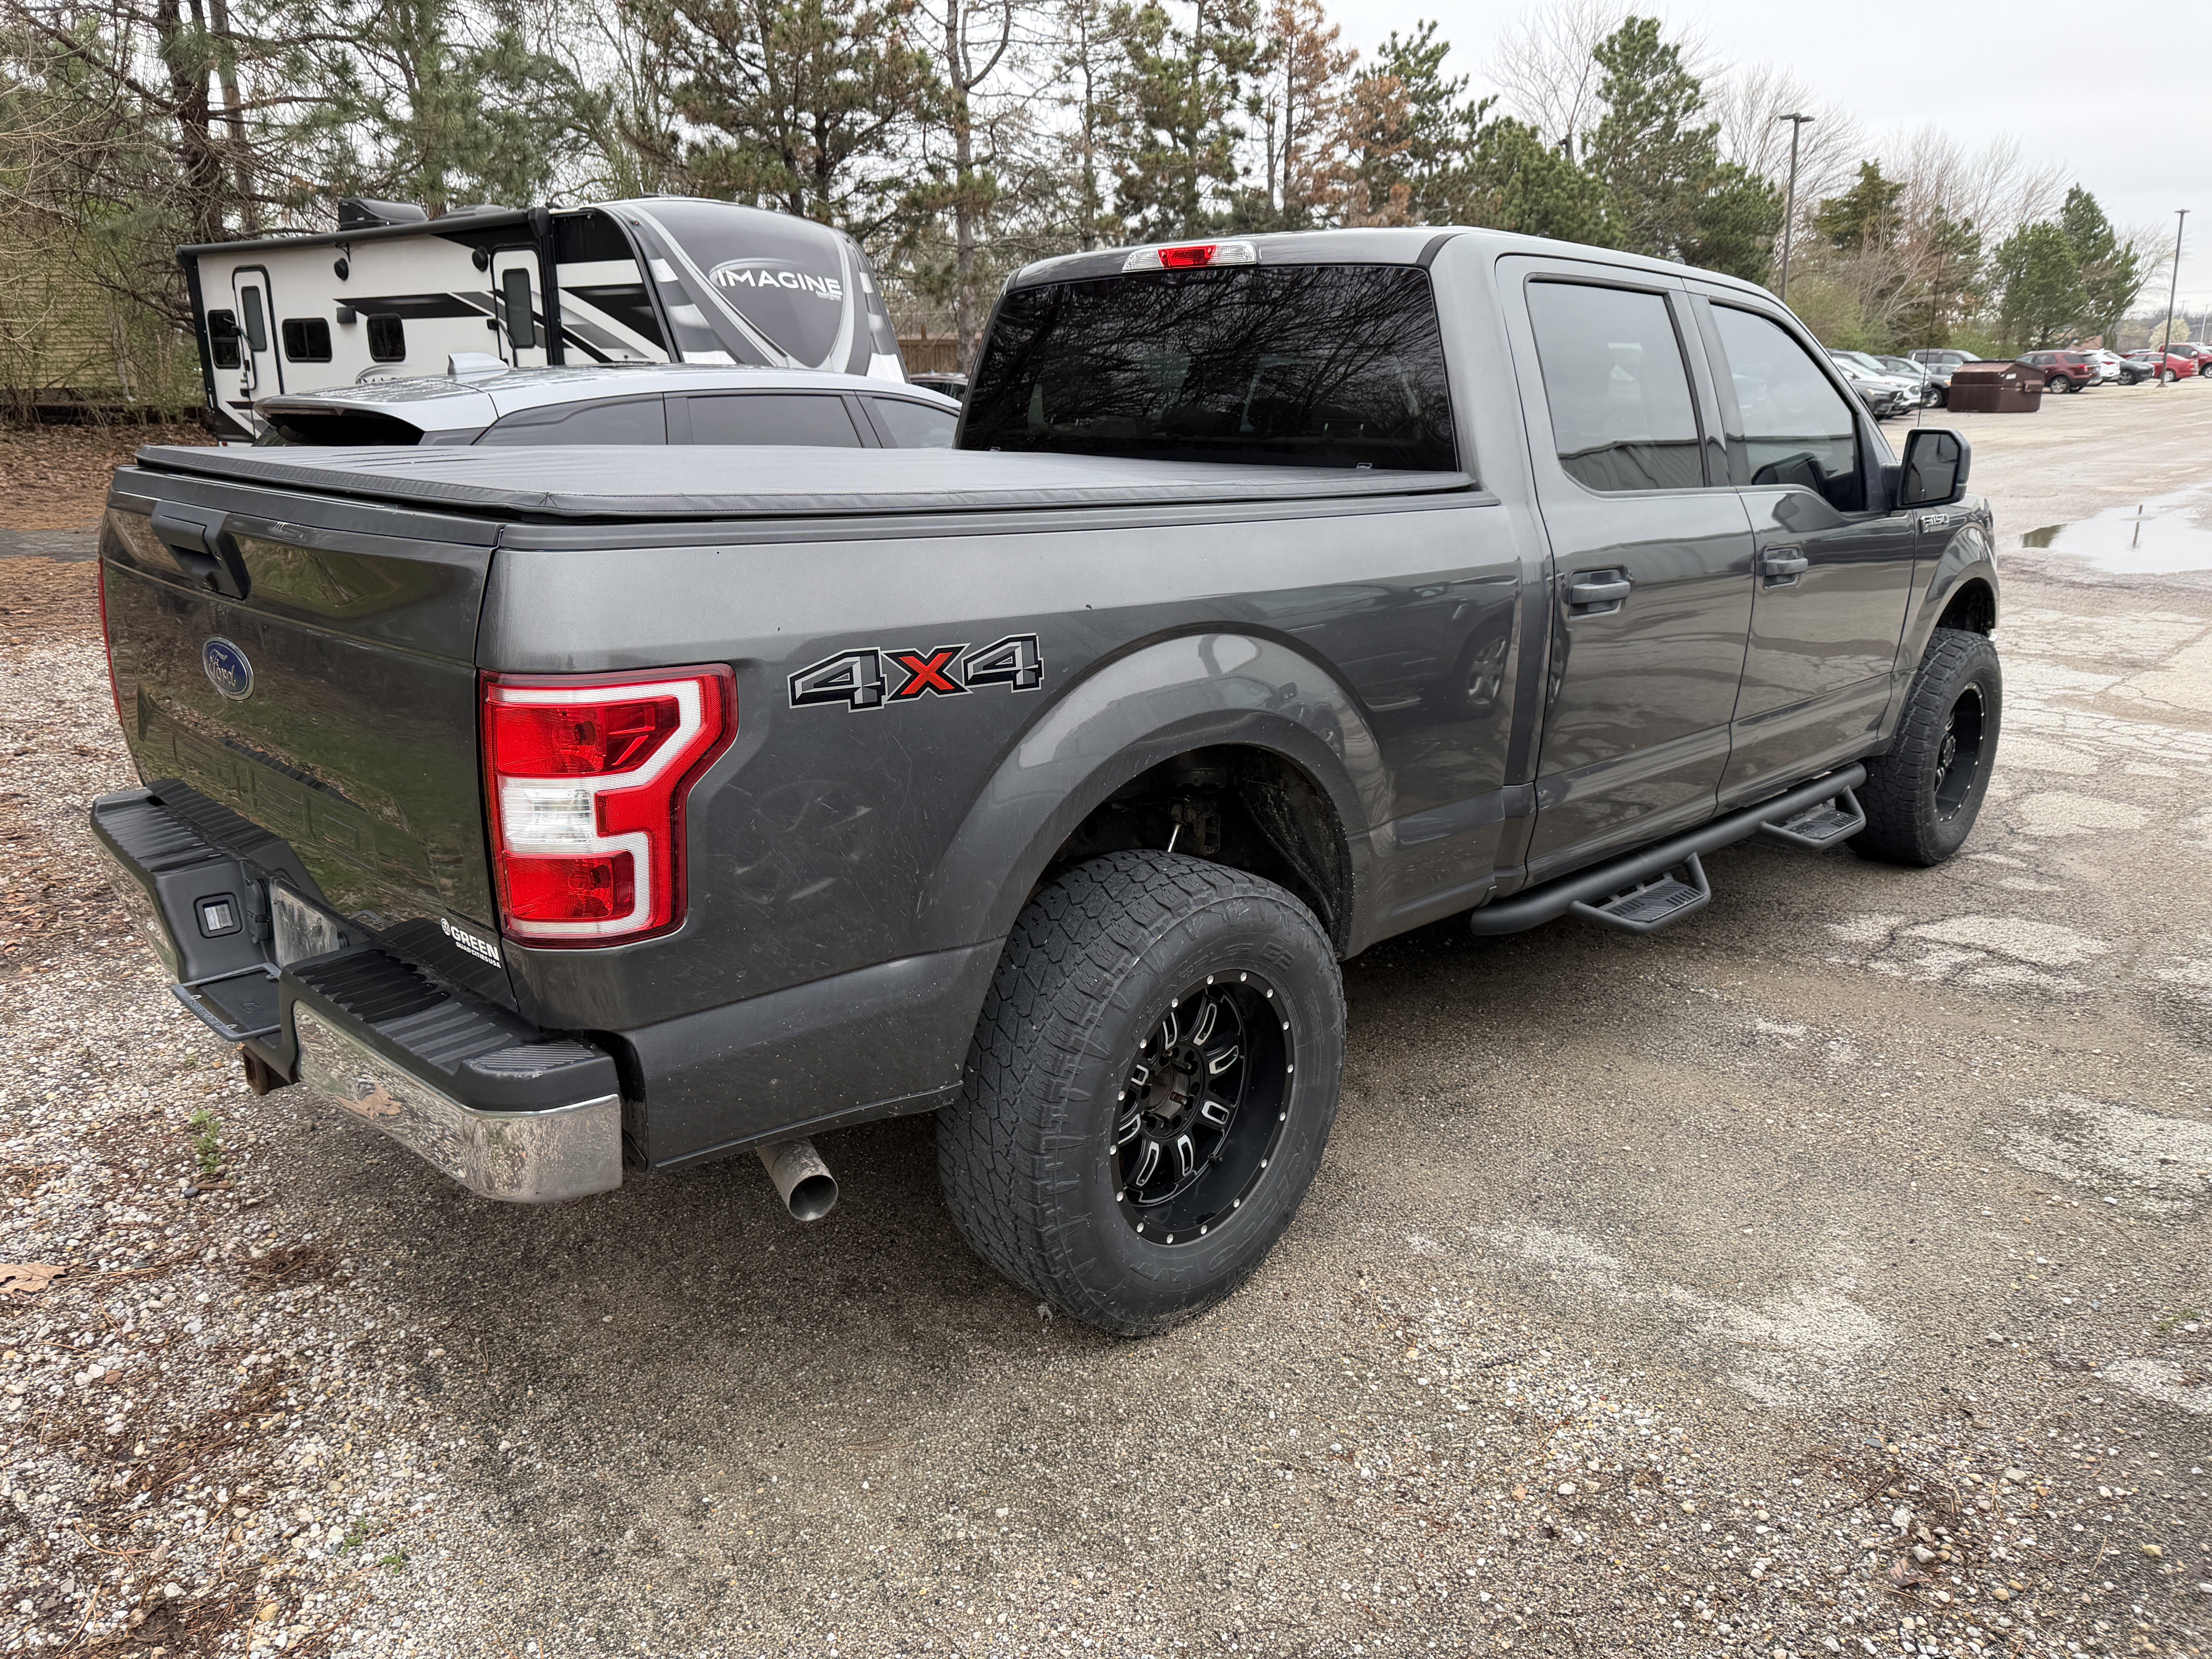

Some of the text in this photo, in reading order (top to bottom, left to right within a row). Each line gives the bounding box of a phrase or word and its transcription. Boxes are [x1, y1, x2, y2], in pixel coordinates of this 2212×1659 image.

[716, 270, 843, 296] IMAGINE
[209, 648, 236, 687] Ford
[450, 926, 500, 961] GREEN
[455, 941, 501, 969] QUAD CITIES USA
